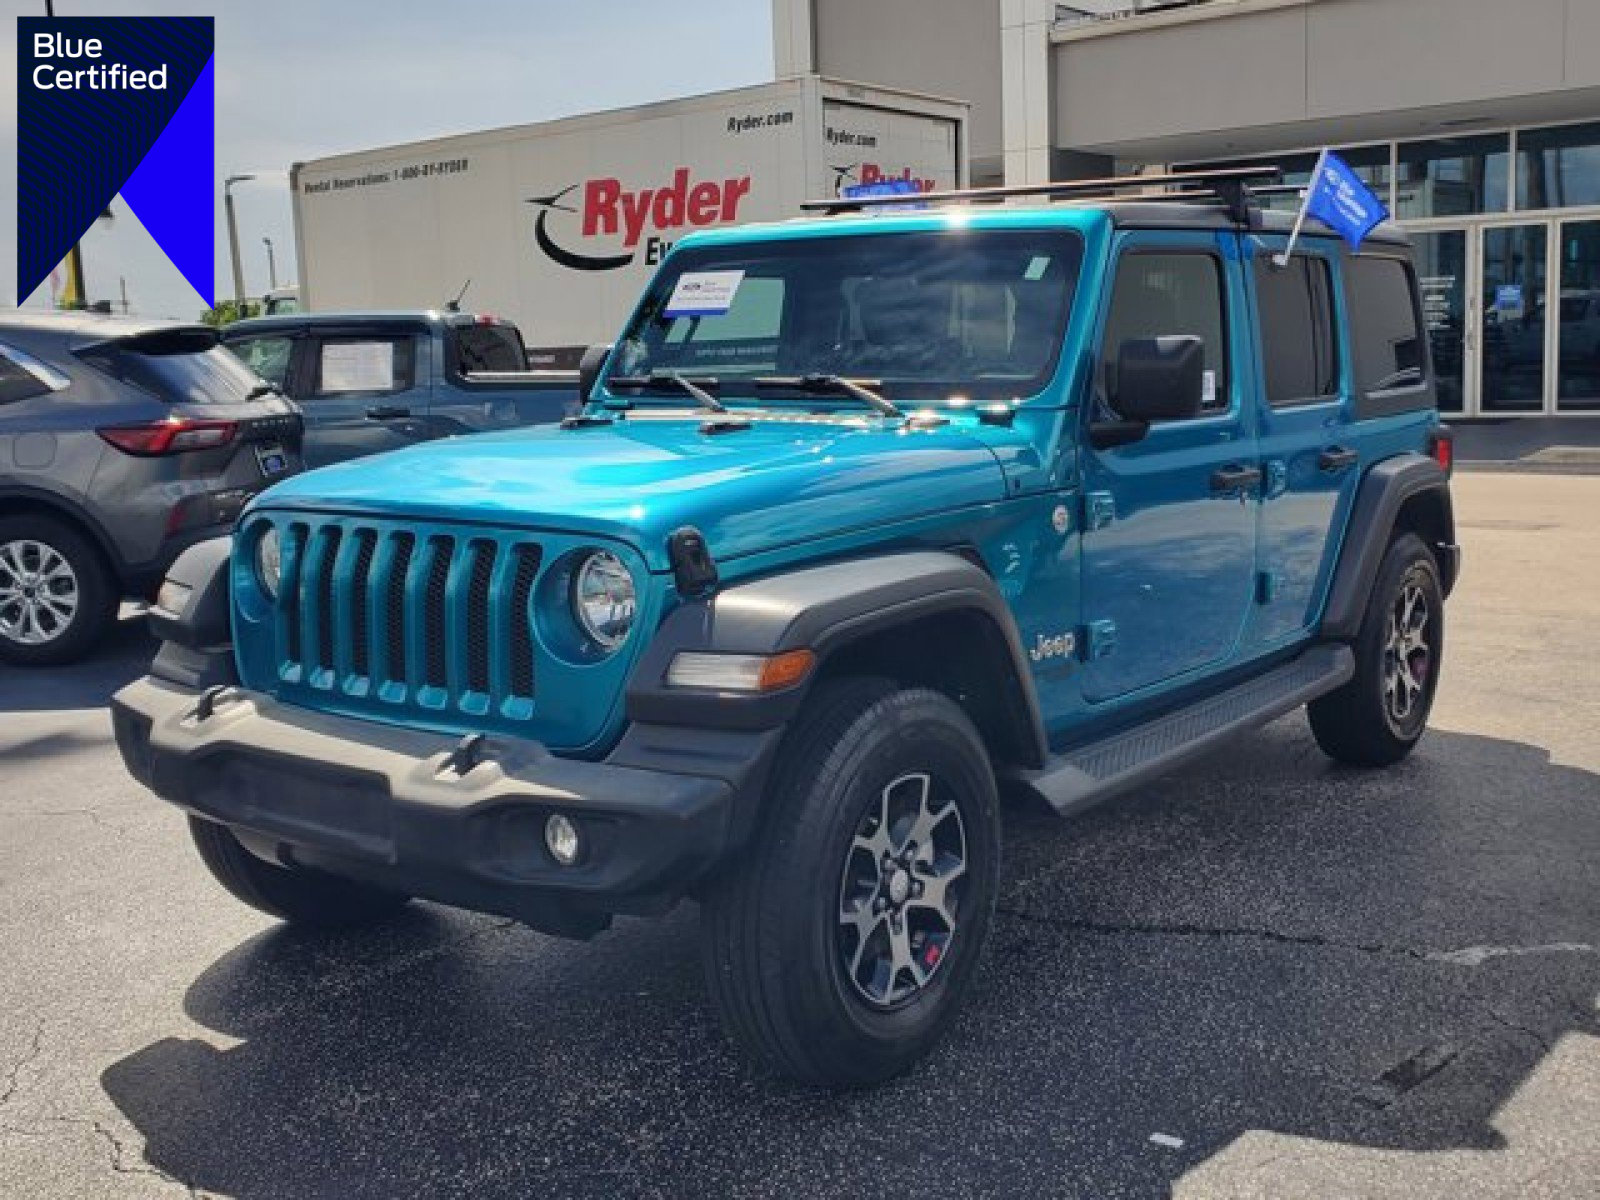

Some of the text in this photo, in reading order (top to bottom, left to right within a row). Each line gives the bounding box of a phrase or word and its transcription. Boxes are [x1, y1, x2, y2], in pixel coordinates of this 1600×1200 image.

[727, 111, 794, 133] Ryder.com
[582, 167, 751, 248] Ryder
[1030, 632, 1075, 661] Jeep
